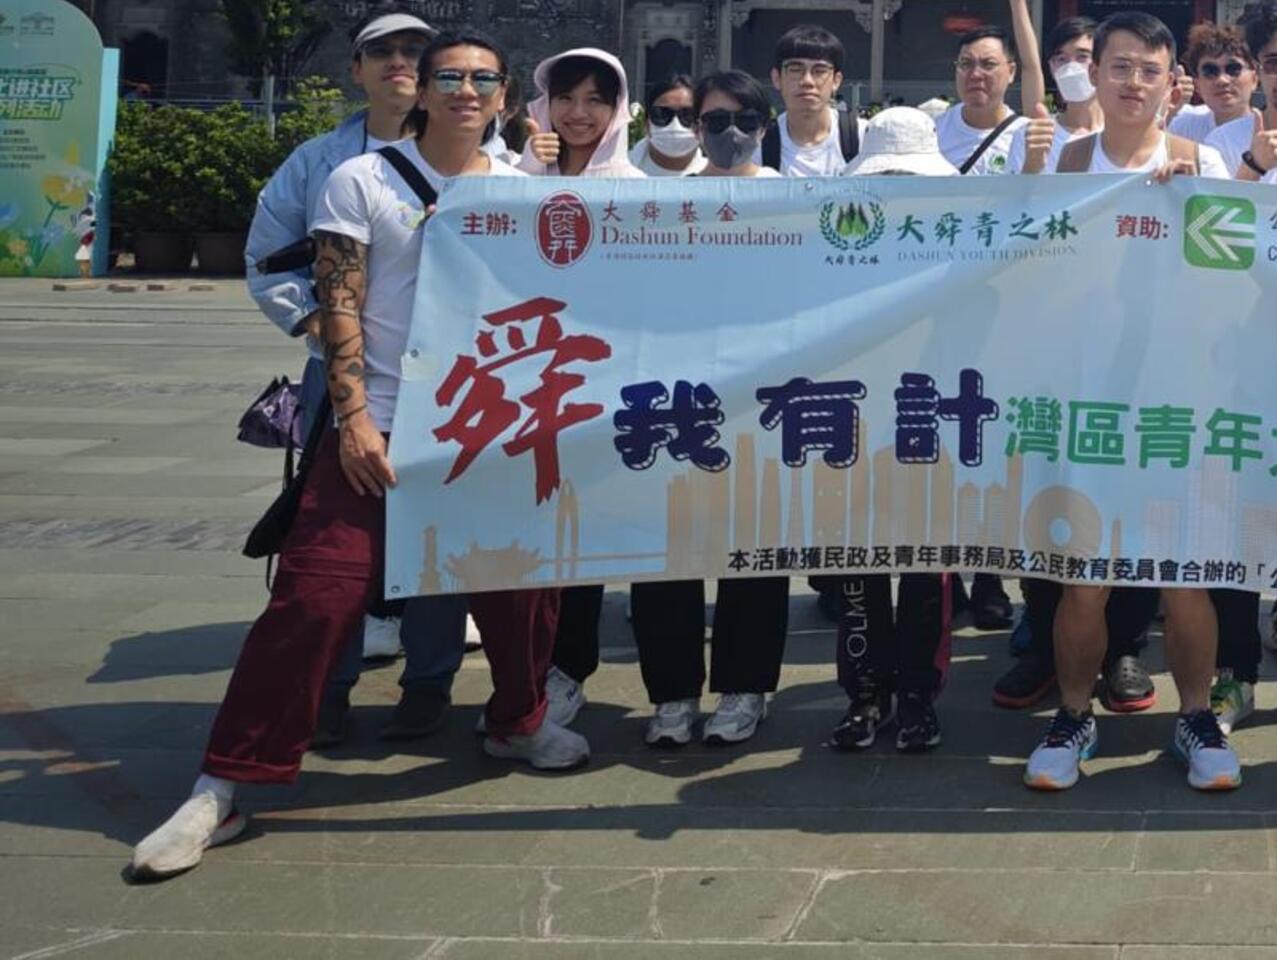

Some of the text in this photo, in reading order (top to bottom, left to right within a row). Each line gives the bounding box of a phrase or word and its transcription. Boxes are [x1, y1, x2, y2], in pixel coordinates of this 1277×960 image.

[602, 200, 738, 223] 大舜基金
[461, 212, 517, 237] 主辦:
[600, 226, 802, 247] Dashun Foundation
[897, 210, 1078, 247] 大舜青之林
[1115, 215, 1168, 241] 資助:
[613, 368, 1001, 474] 我有計
